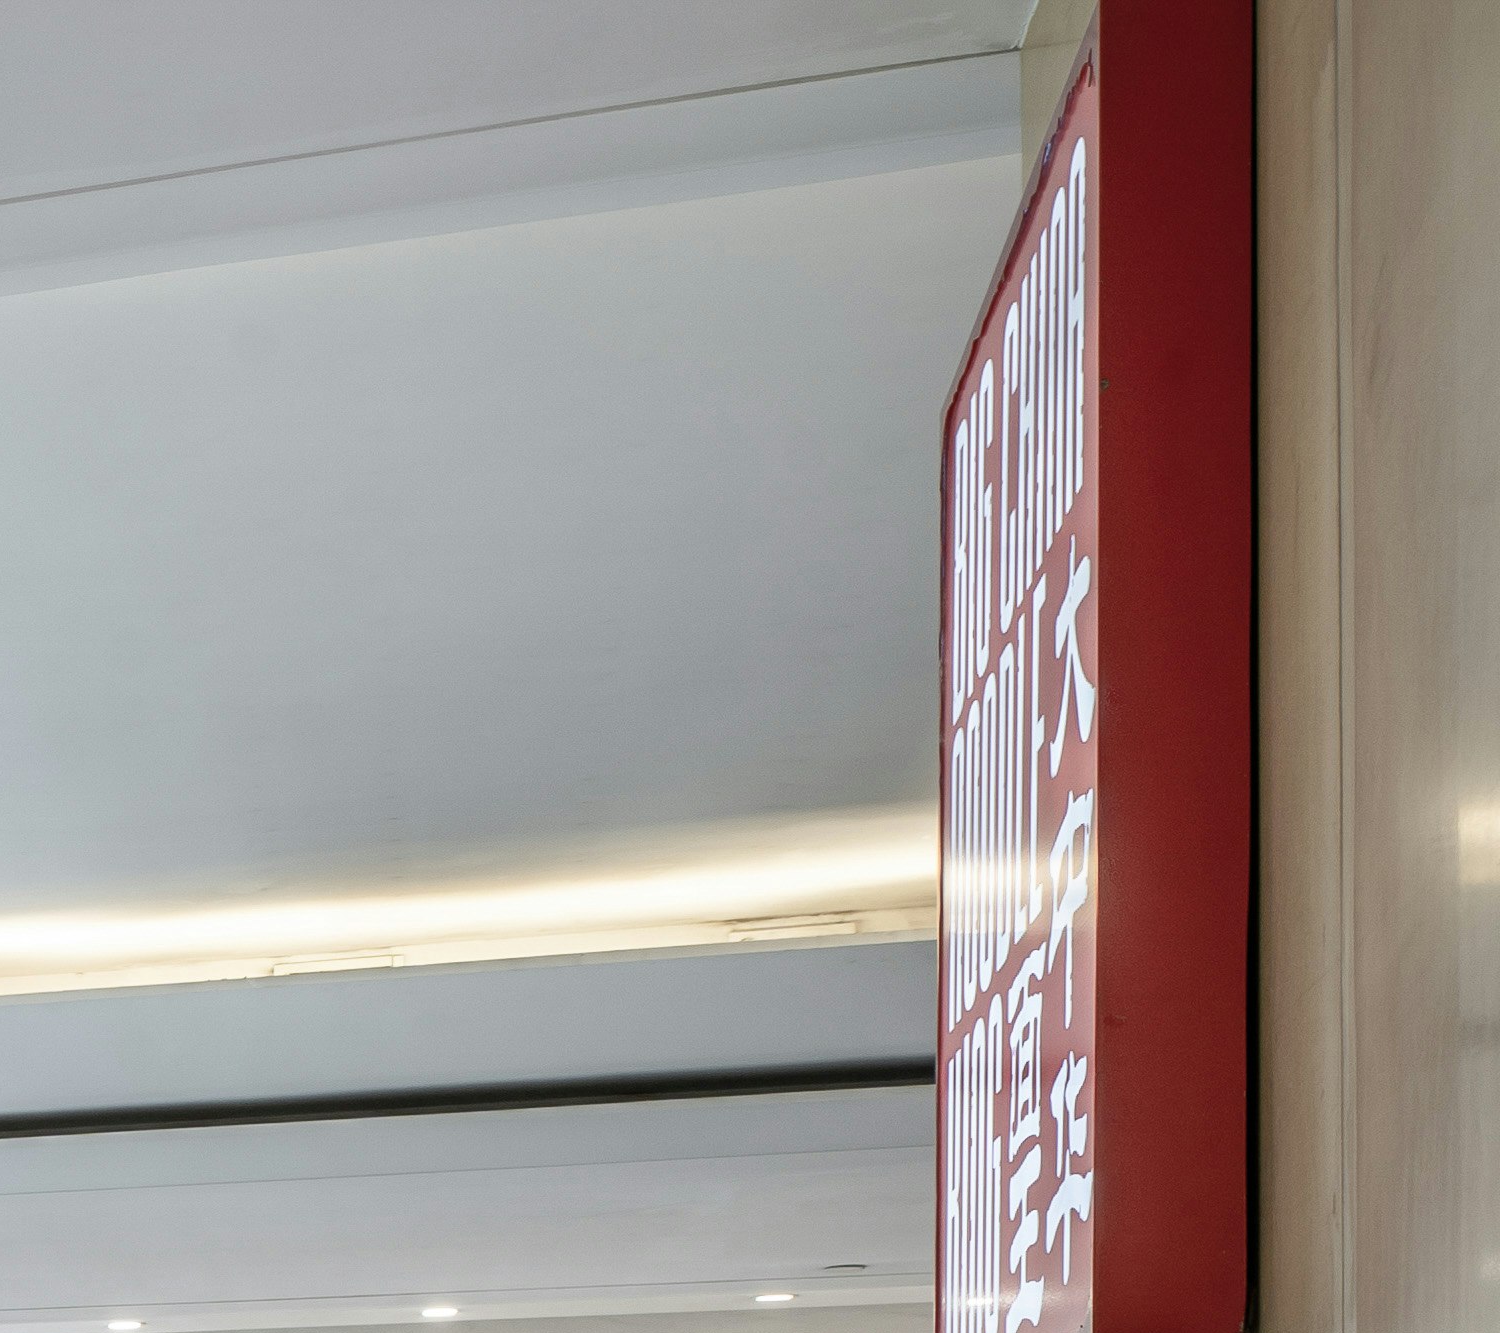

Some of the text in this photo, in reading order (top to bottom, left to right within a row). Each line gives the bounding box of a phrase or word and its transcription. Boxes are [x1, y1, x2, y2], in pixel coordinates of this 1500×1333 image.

[952, 136, 1087, 726] BIG CHINA
[948, 572, 1047, 1033] NOODLE
[1046, 535, 1097, 1287] 大中华
